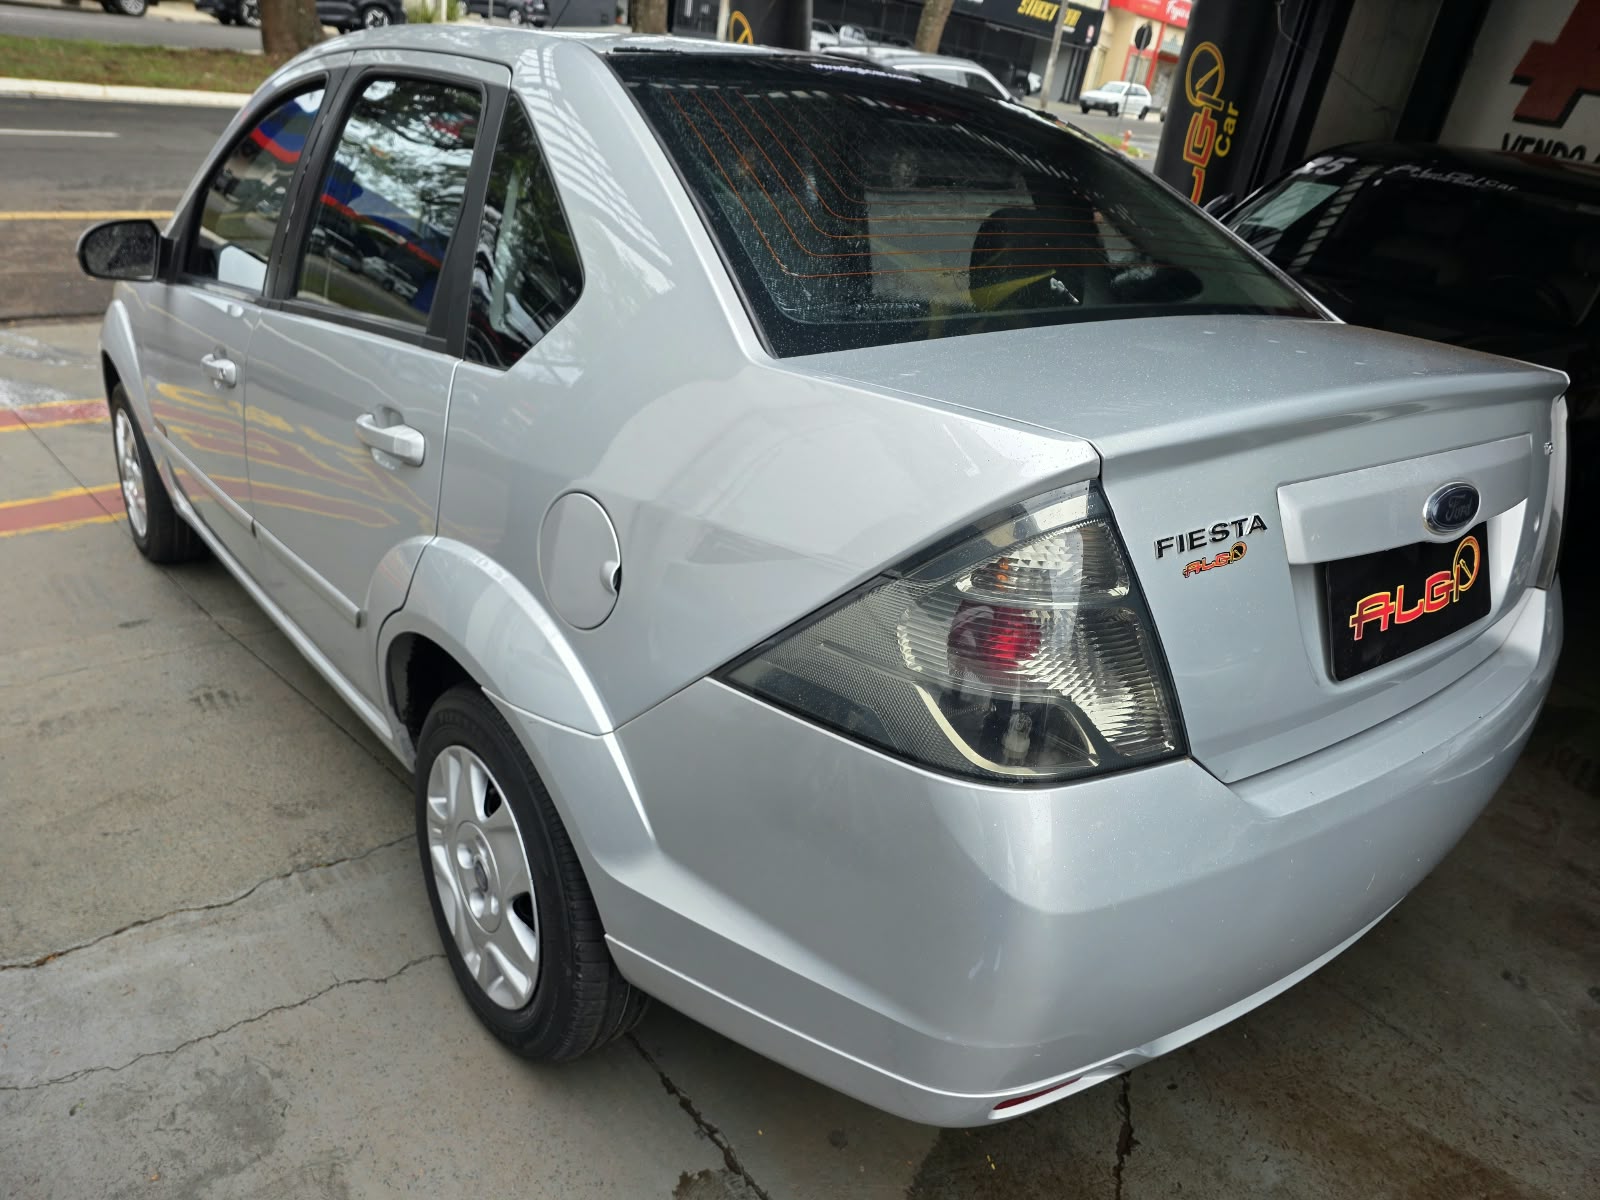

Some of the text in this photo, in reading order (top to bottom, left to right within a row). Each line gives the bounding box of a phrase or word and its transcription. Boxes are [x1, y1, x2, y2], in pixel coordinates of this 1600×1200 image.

[1214, 101, 1239, 157] Car
[1154, 512, 1268, 560] FIESTA
[1182, 541, 1248, 578] ALGO
[1349, 535, 1481, 641] ALGO
